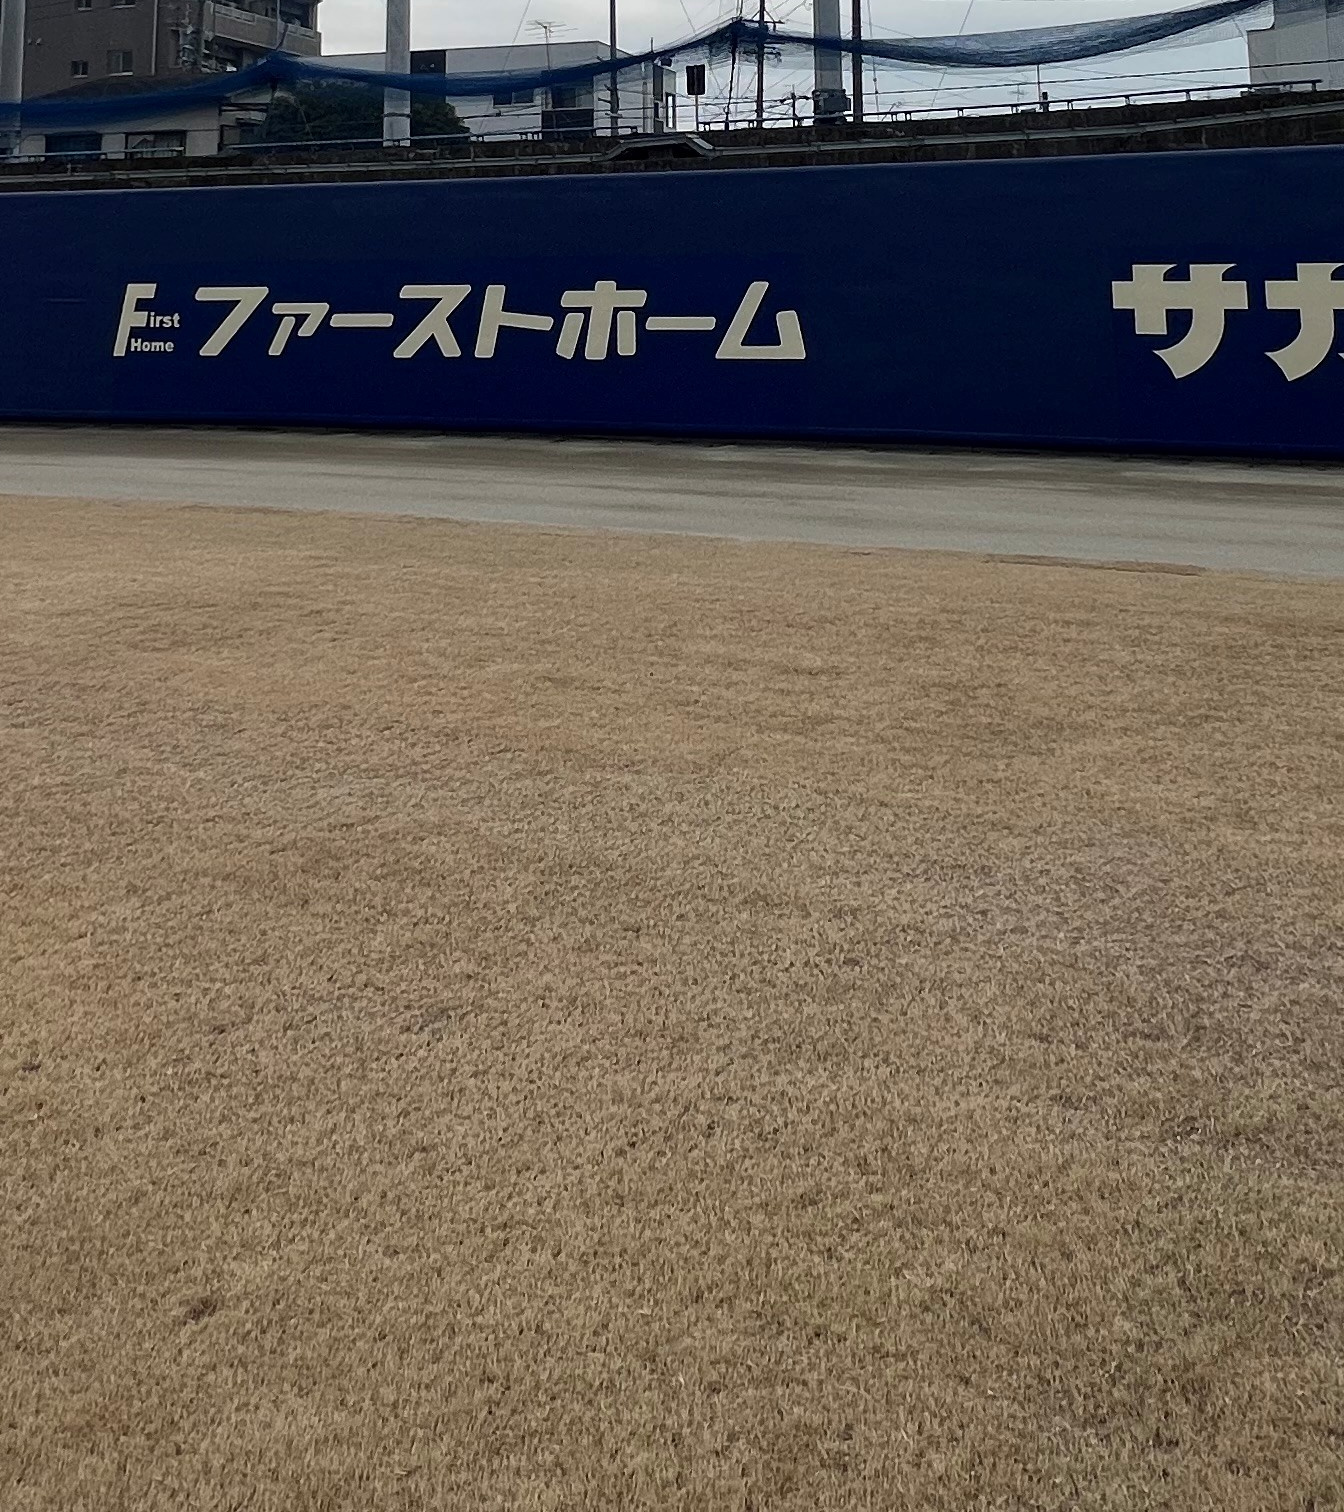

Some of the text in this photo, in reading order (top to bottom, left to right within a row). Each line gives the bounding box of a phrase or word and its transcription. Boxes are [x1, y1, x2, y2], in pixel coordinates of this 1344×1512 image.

[194, 280, 807, 361] ファーストホーム
[130, 338, 175, 352] Home
